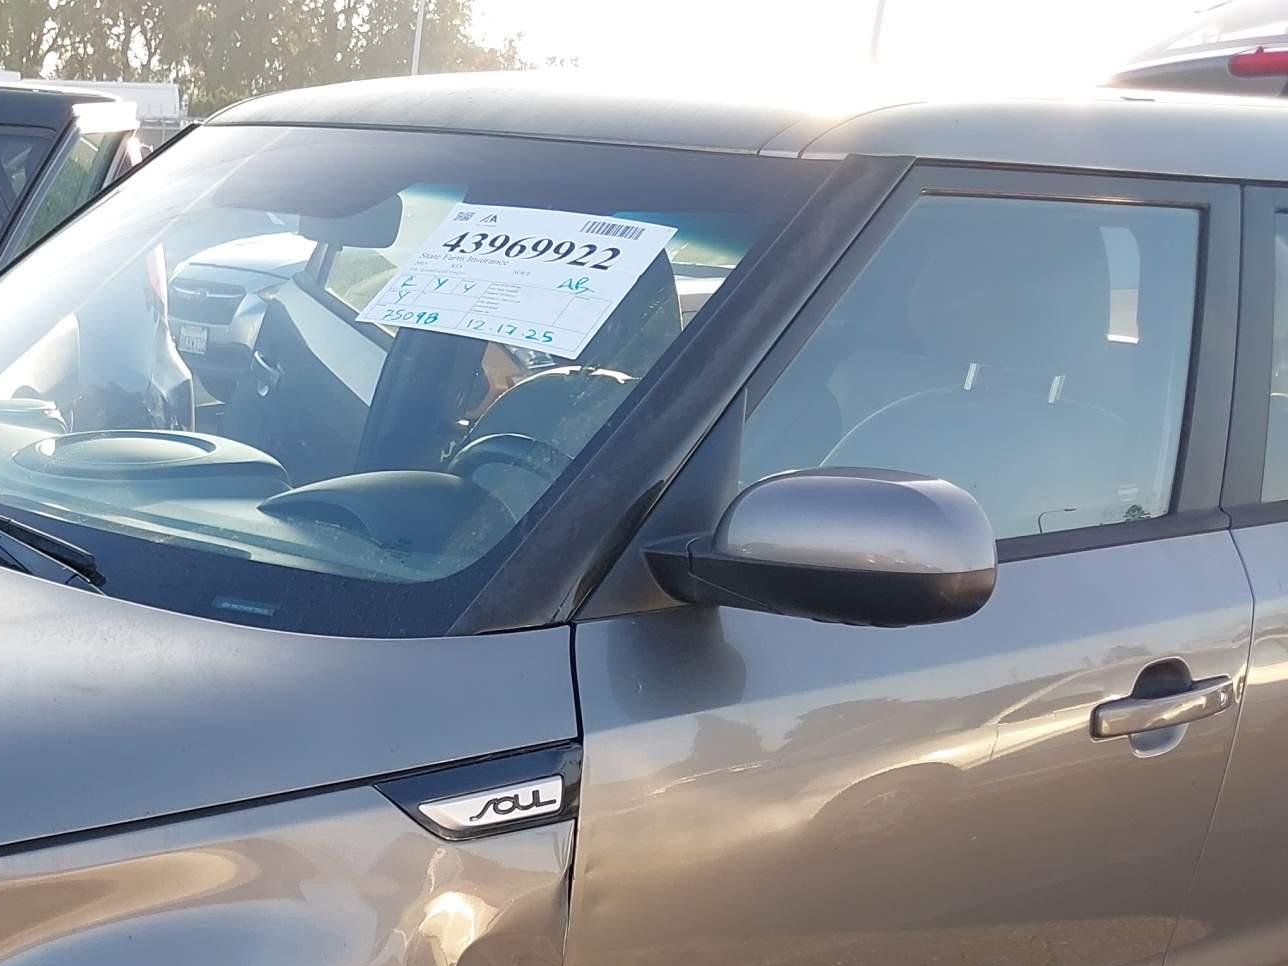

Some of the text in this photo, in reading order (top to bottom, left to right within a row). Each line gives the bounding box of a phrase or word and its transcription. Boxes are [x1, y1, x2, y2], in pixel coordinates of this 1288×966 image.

[442, 231, 621, 271] 43969922
[466, 256, 510, 266] Insurance
[469, 789, 558, 822] SOUL
